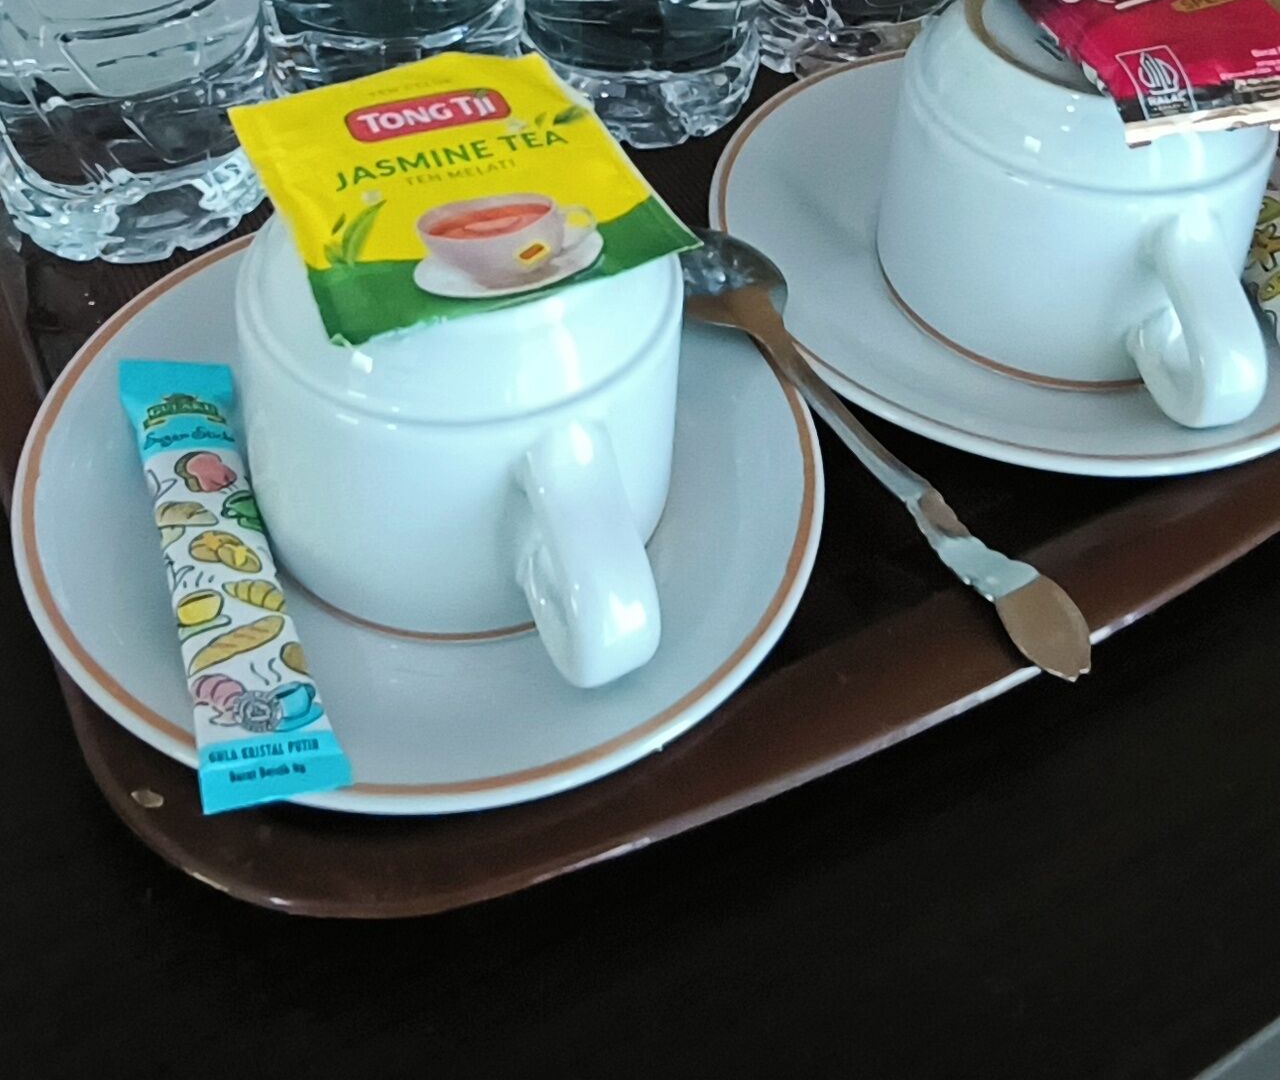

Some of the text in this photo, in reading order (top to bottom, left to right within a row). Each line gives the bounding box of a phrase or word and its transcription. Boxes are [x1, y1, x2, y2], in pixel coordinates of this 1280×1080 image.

[356, 103, 454, 135] TONG
[335, 130, 569, 192] JASMINE TEA
[405, 159, 517, 186] TEH MELATI
[208, 749, 238, 763] GULA
[241, 743, 285, 760] KRISTAL
